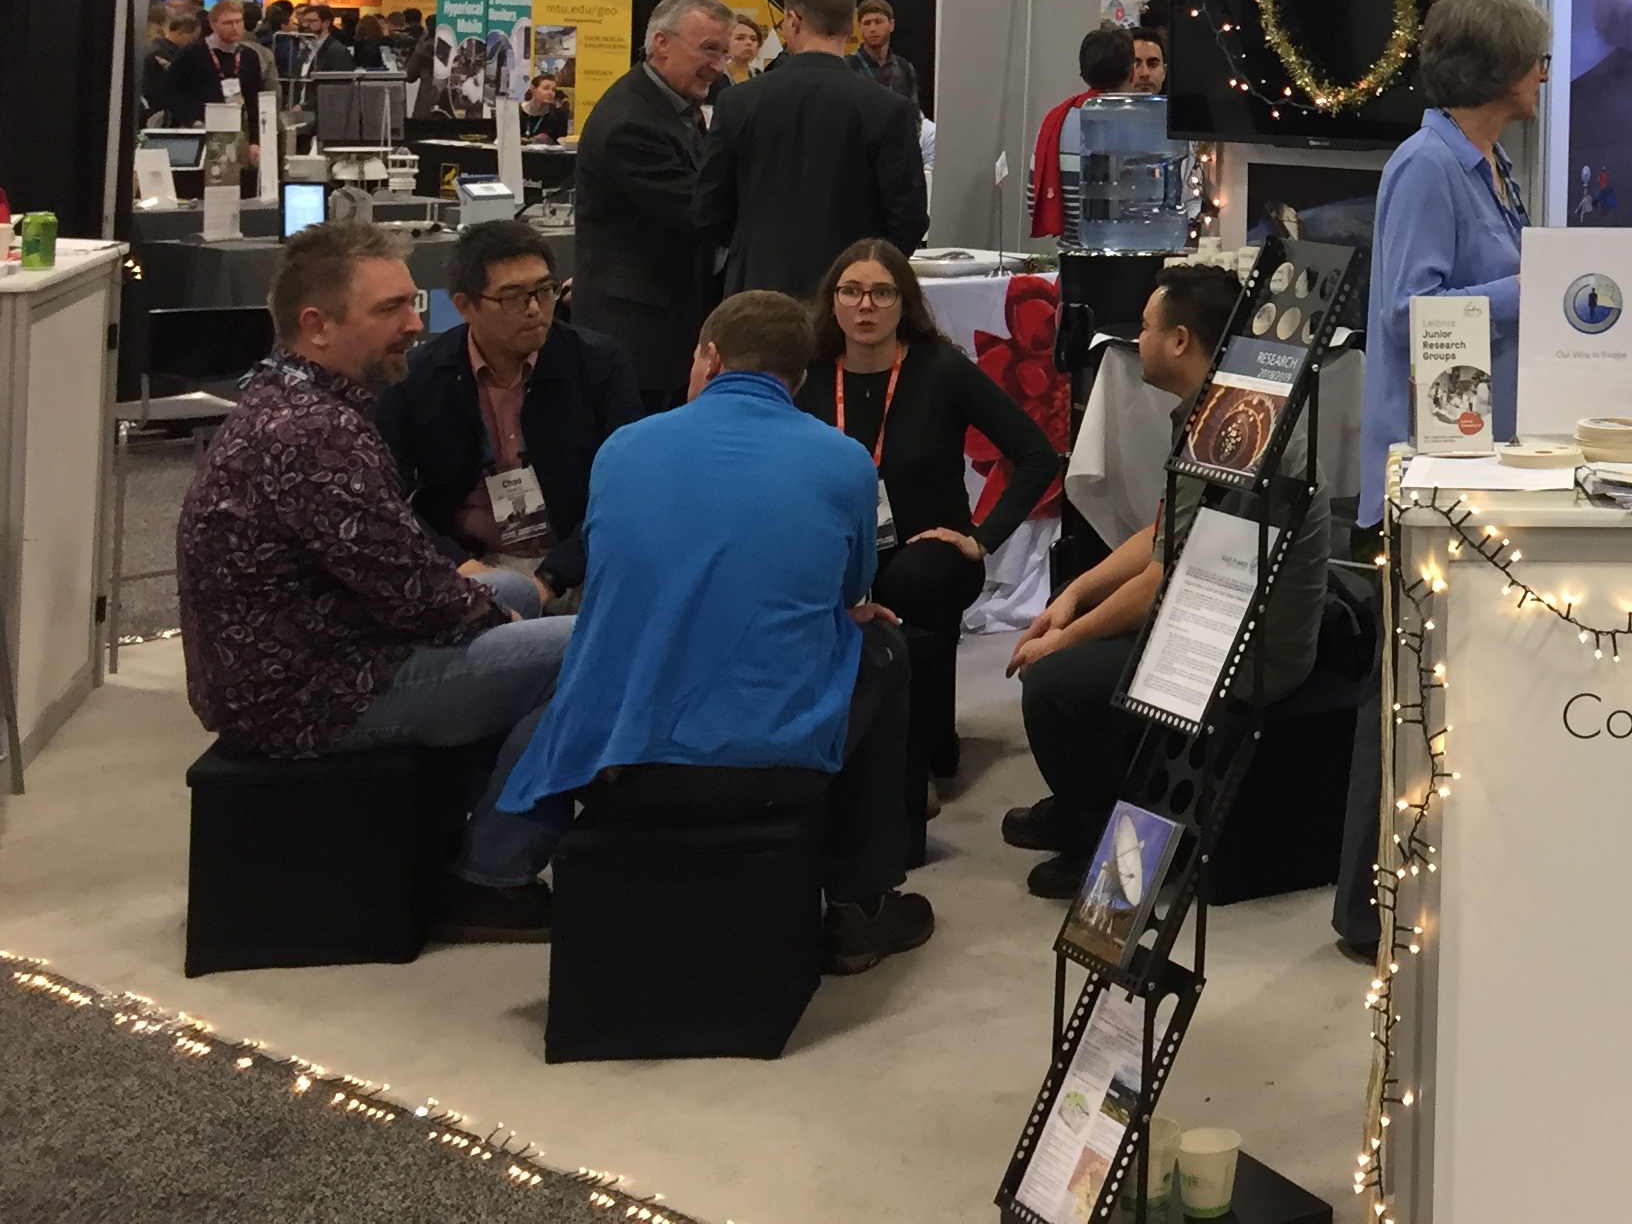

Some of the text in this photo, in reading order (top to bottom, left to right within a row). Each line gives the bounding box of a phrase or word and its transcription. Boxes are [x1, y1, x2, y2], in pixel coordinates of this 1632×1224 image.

[546, 4, 618, 18] mtu.edu/geo
[1422, 319, 1456, 328] Leibniz
[1422, 330, 1453, 339] Junior
[1422, 340, 1467, 350] Research
[1256, 351, 1299, 370] RESEARCH
[1422, 351, 1457, 362] Groups
